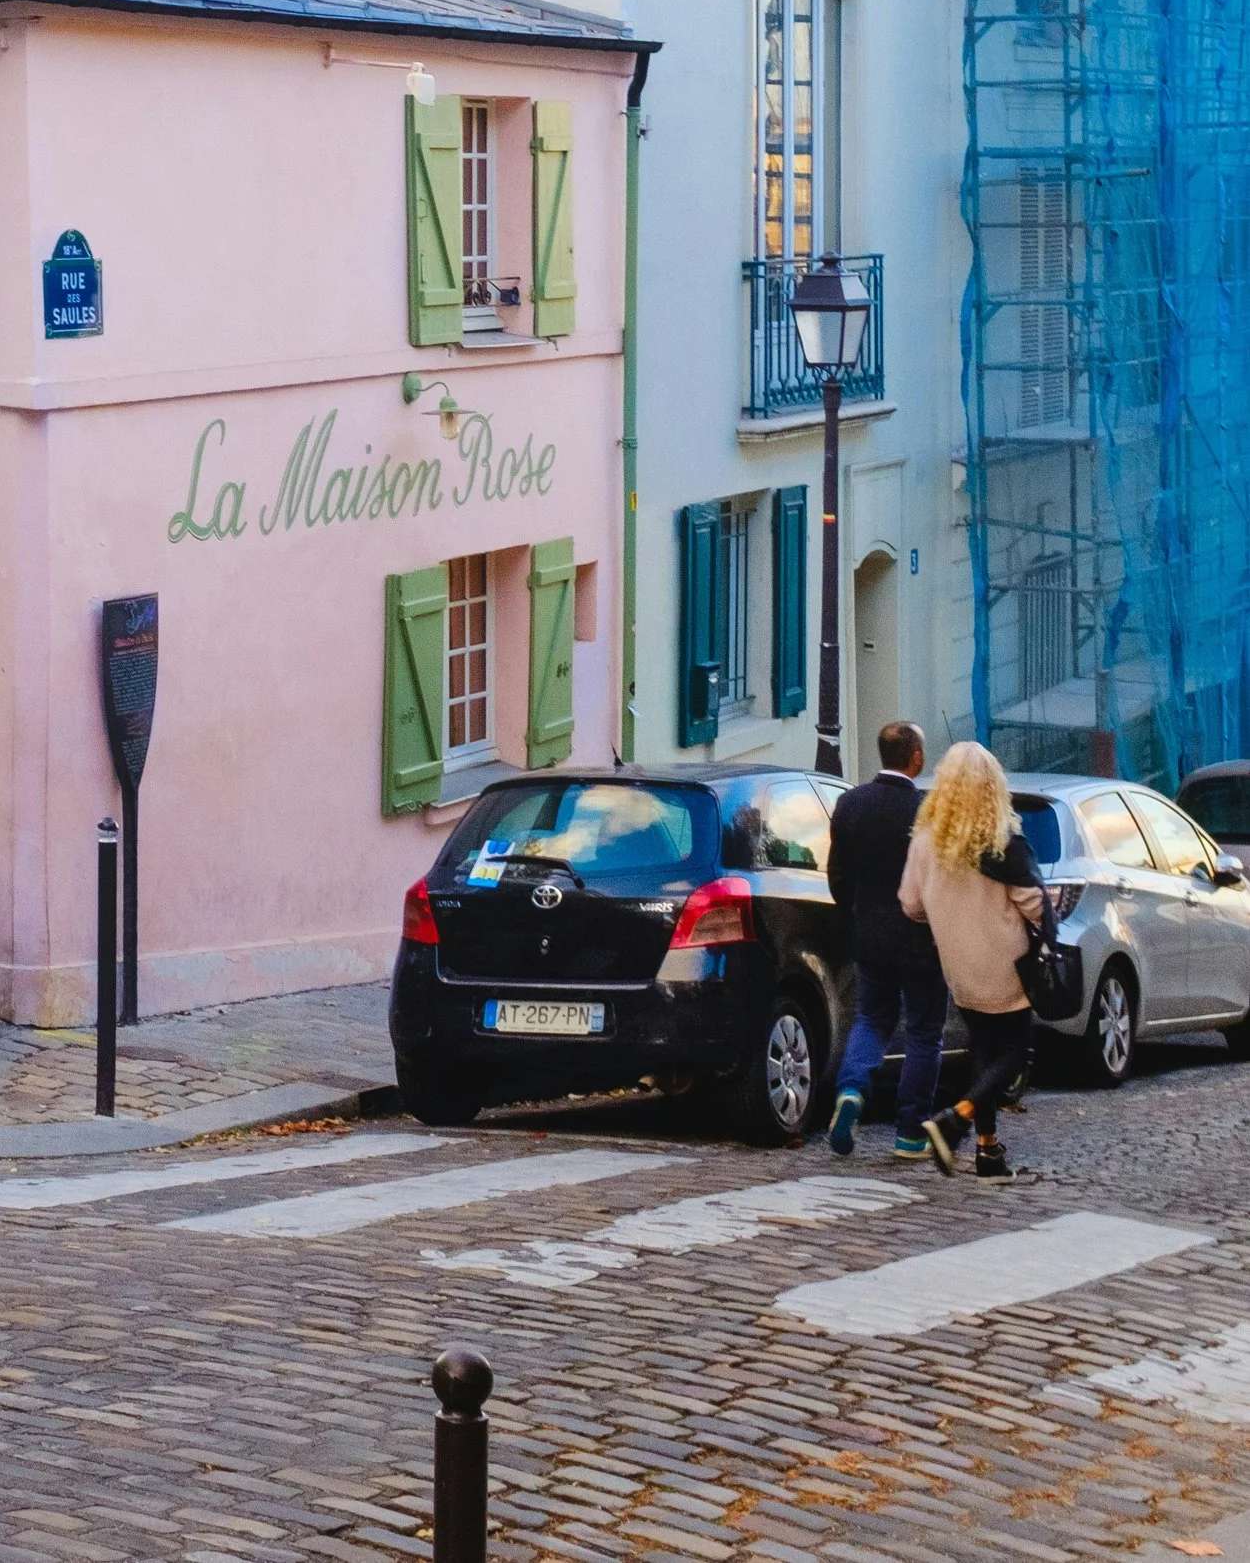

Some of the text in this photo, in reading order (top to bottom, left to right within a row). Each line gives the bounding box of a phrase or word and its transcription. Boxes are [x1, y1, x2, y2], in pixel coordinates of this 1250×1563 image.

[61, 272, 86, 290] RUE
[67, 293, 81, 303] DES
[52, 306, 97, 325] SAULES
[167, 407, 557, 544] La Maison Rose
[497, 1004, 591, 1026] AT-267-PN
